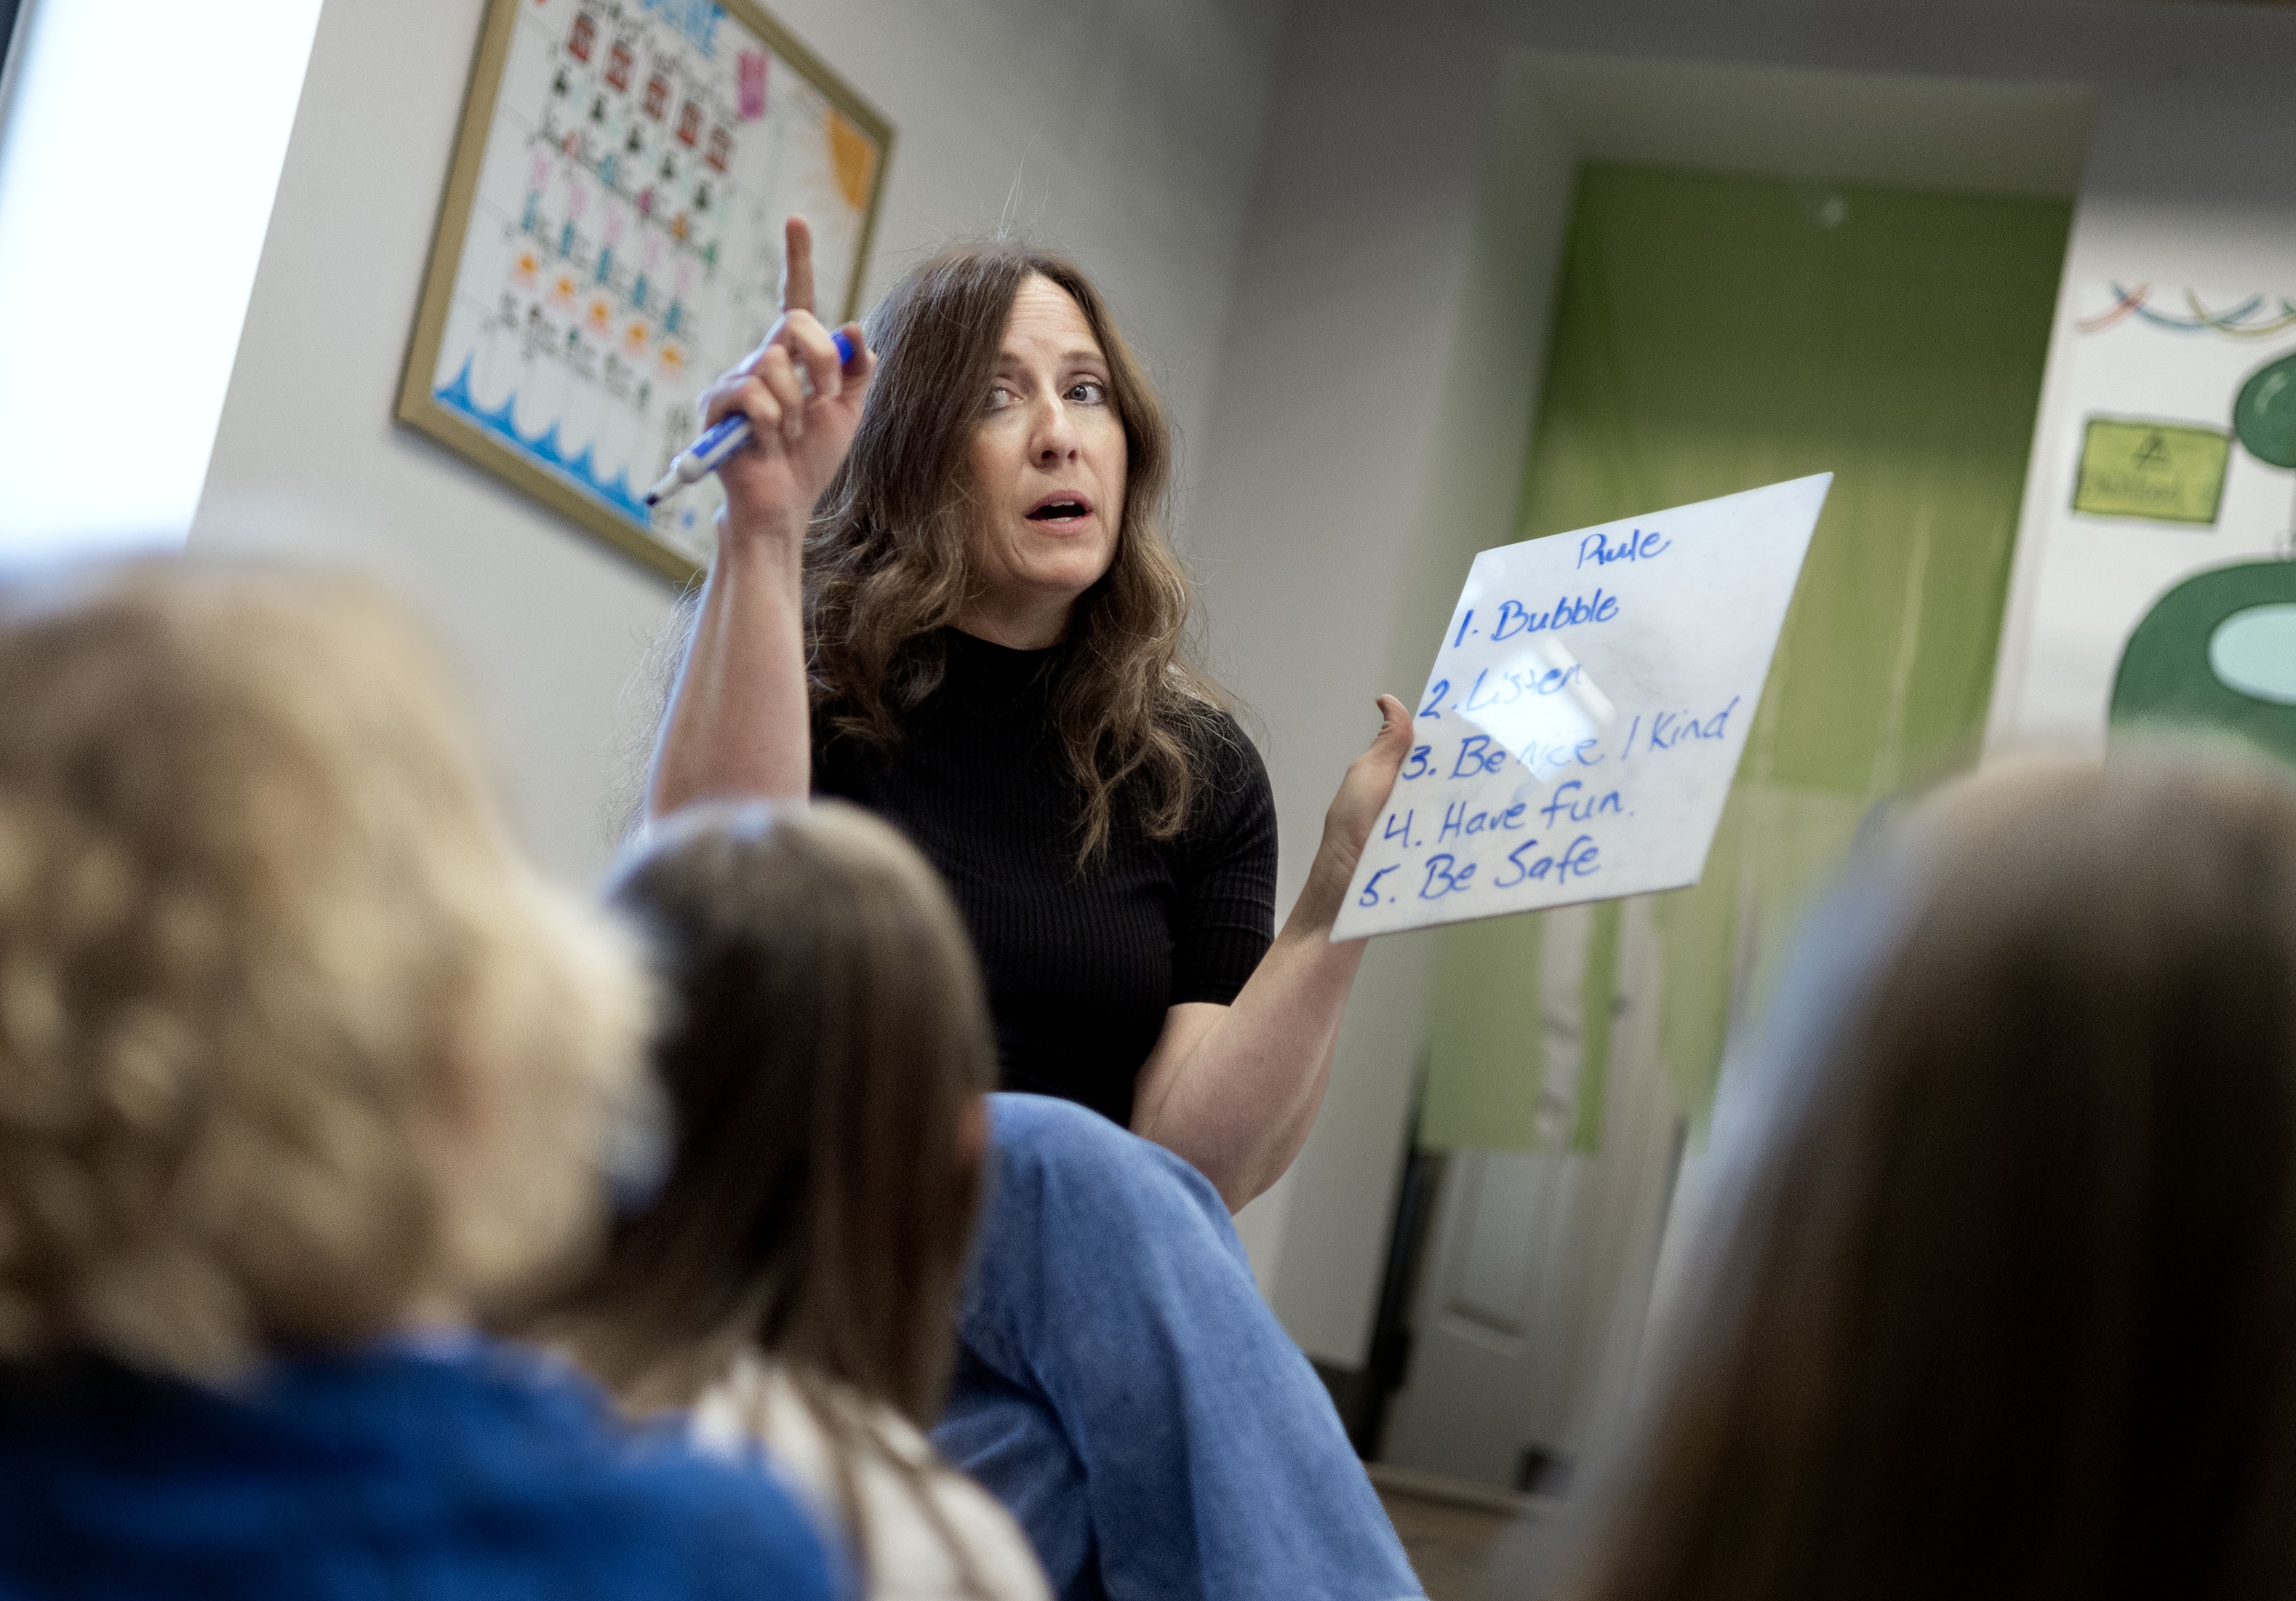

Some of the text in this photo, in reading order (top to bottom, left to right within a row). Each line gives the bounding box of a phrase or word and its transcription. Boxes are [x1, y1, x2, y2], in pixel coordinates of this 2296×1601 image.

[1577, 529, 1671, 569] Rule
[1454, 588, 1619, 648] 1. Bubble
[1419, 663, 1582, 719] 2. Listen
[1402, 746, 1436, 780] 3.
[1448, 733, 1507, 780] Be
[1383, 808, 1422, 848] 4.
[1438, 800, 1527, 843] Have
[1358, 835, 1601, 907] 5. Be Safe
